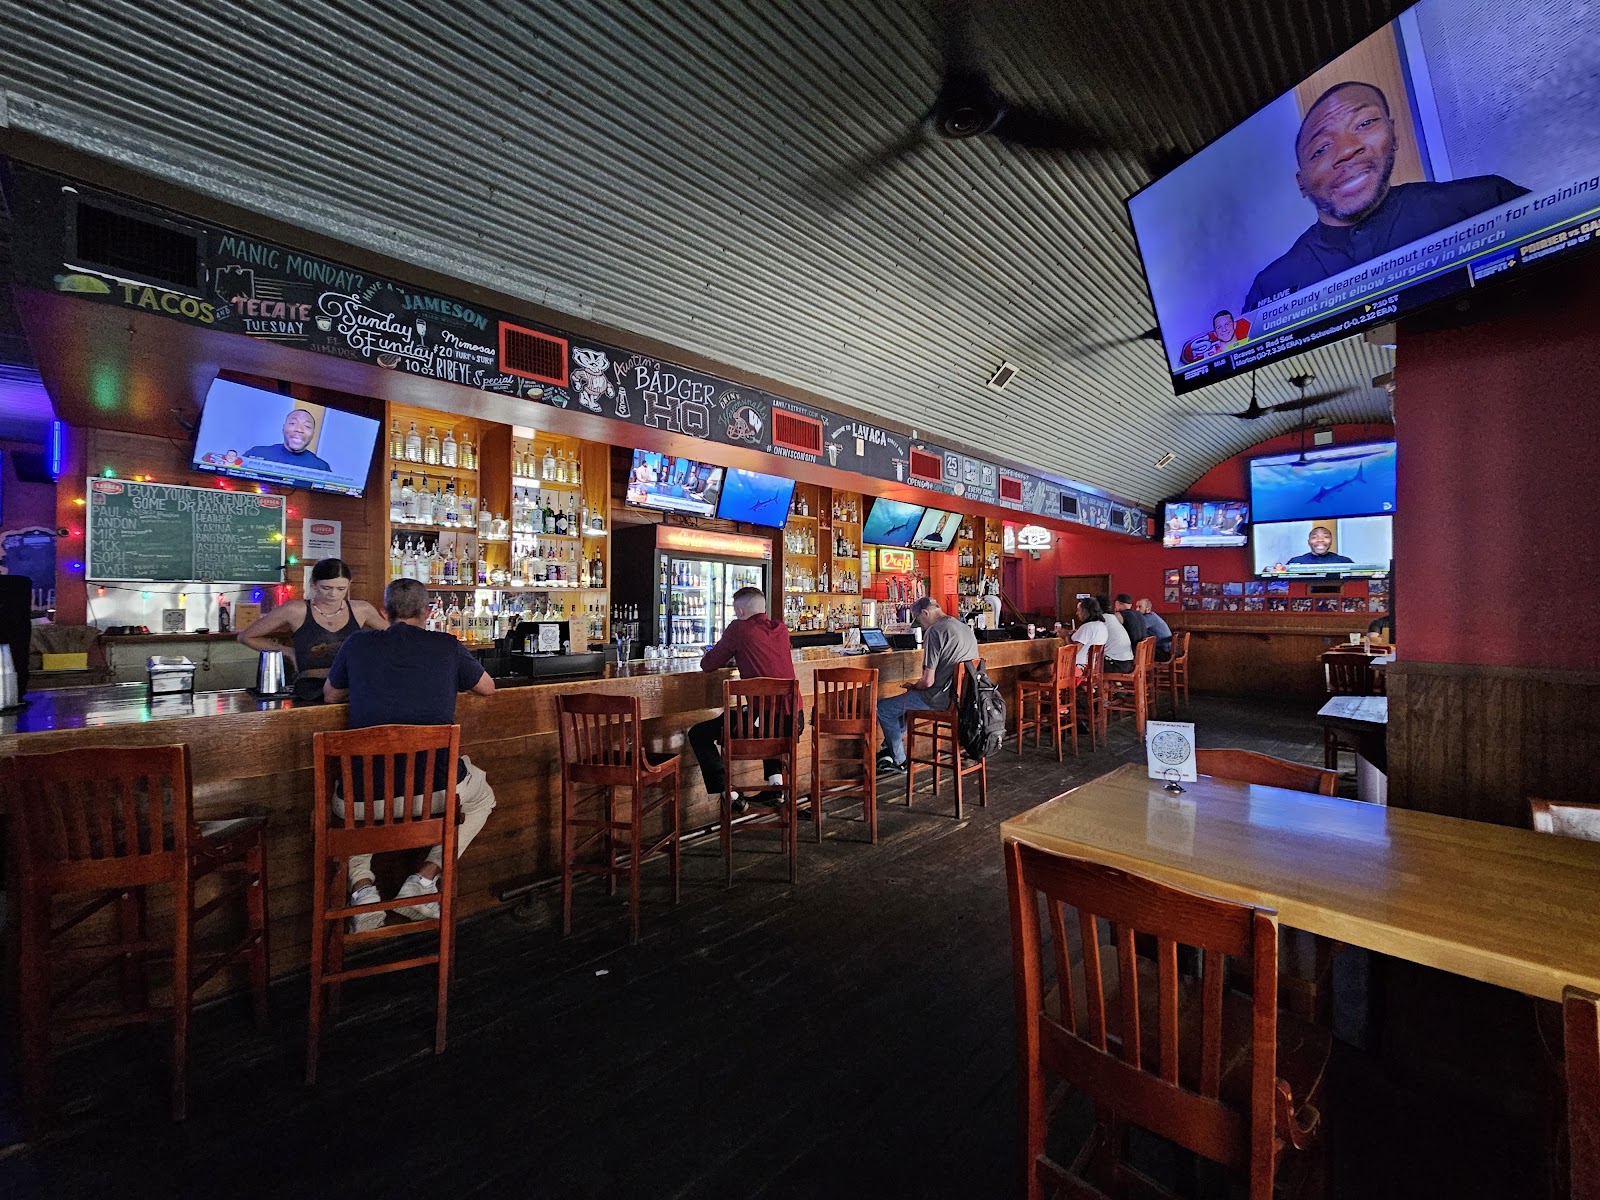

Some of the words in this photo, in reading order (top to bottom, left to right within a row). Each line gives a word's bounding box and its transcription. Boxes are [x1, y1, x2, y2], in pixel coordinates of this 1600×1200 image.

[1262, 303, 1289, 321] Brock
[1291, 291, 1320, 309] Purdy
[1323, 270, 1368, 294] "cleared
[1370, 250, 1418, 277] without
[1421, 214, 1502, 257] restriction"
[1506, 205, 1530, 222] for
[1533, 175, 1600, 212] training
[218, 235, 280, 270] MANIC
[286, 254, 364, 293] MONDAY?
[362, 281, 383, 302] HAVE
[387, 283, 394, 291] A
[1263, 303, 1318, 331] Underwent
[1319, 292, 1347, 311] right
[1348, 277, 1385, 298] elbow
[1386, 255, 1439, 284] surgery
[1441, 249, 1456, 262] in
[1458, 230, 1506, 256] March
[117, 281, 215, 324] TACOS
[216, 306, 231, 319] AND
[230, 295, 312, 321] TECATE
[1257, 297, 1273, 308] NFL
[1273, 287, 1291, 301] LIVE
[330, 297, 413, 343] Sunday
[402, 294, 489, 331] JAMESON
[242, 318, 304, 334] TUESDAY
[340, 326, 434, 368] Funday
[433, 344, 453, 358] $20
[441, 330, 496, 356] Mimosas
[1233, 349, 1256, 361] Braves
[1265, 338, 1280, 349] Red
[1279, 333, 1294, 344] Sox
[455, 350, 472, 361] TURF
[405, 358, 420, 373] 10
[421, 367, 436, 376] oz
[436, 357, 472, 385] RIBEYE
[613, 354, 661, 385] Austin's
[473, 369, 515, 391] Special
[634, 365, 717, 409] BADGER
[720, 391, 741, 410] DRINK
[643, 390, 710, 438] HQ
[852, 422, 887, 447] LAVACA
[946, 456, 958, 470] 25
[127, 484, 160, 500] BUY
[162, 487, 196, 502] YOUR
[131, 496, 167, 511] SOME
[91, 505, 122, 518] PAUL
[91, 517, 137, 530] LANDON
[91, 528, 117, 541] MIR
[91, 540, 121, 552] MCK
[92, 551, 126, 563] SOPH
[91, 562, 129, 575] TWEE
[883, 552, 912, 574] Draft
